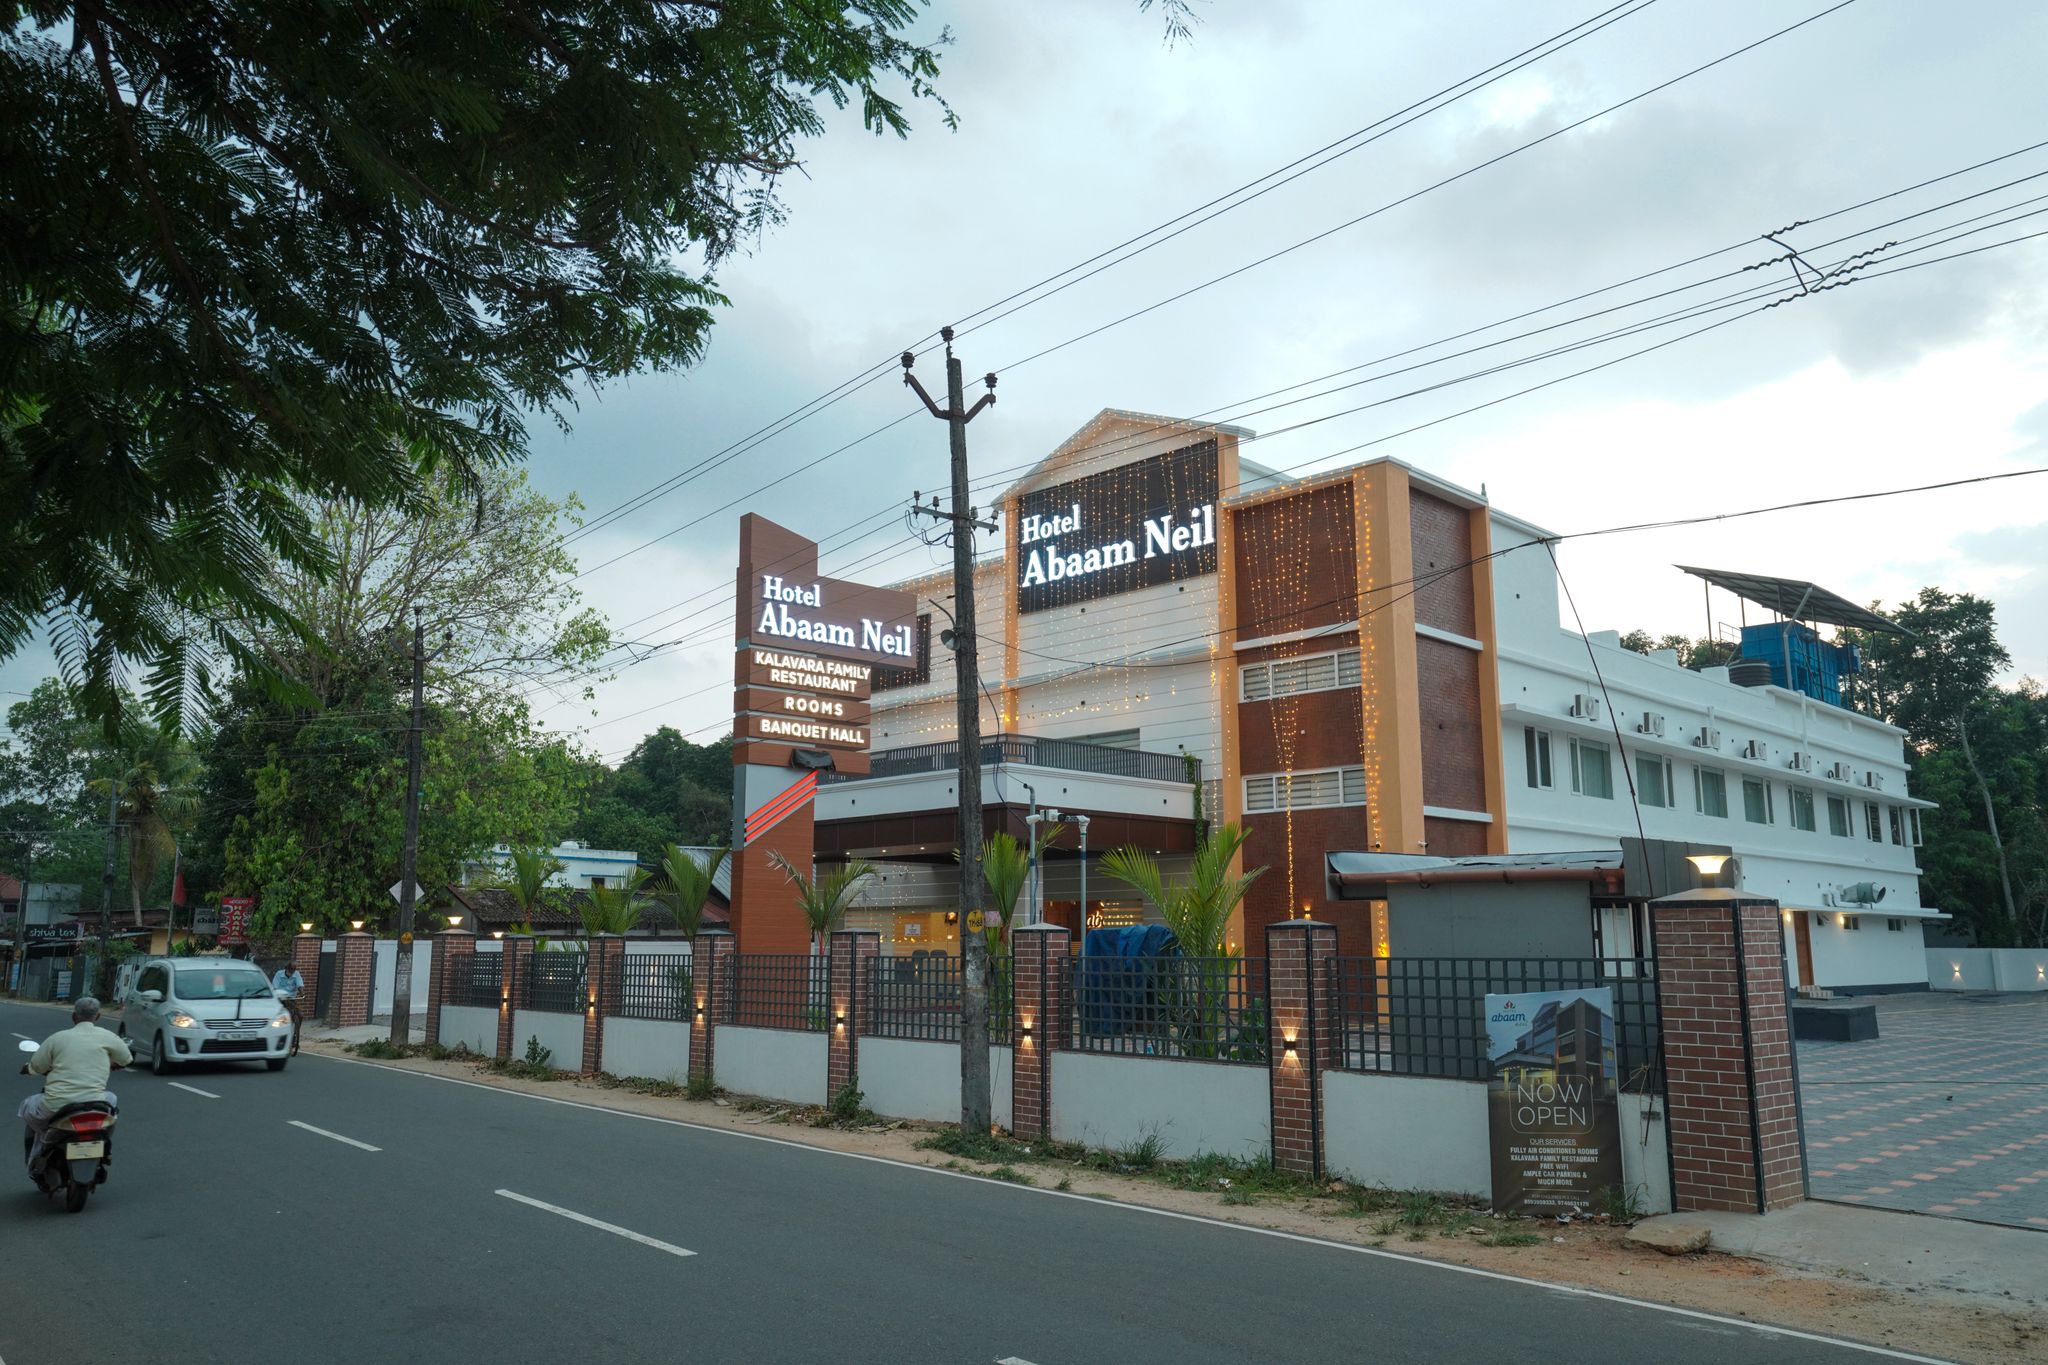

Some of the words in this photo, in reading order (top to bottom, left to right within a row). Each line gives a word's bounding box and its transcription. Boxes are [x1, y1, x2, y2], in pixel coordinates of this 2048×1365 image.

[1021, 504, 1081, 544] Hotel
[1021, 539, 1136, 588] Abaam
[1144, 504, 1216, 559] Neil
[762, 574, 821, 608] Hotel
[758, 602, 856, 648] Abaam
[861, 618, 912, 657] Neil
[754, 651, 824, 674] KALAVARA
[827, 661, 871, 680] FAMILY
[770, 669, 857, 693] RESTAURANT
[784, 696, 844, 717] ROOMS
[760, 719, 826, 740] BANQUET
[830, 727, 865, 744] HALL
[29, 928, 55, 937] shiva
[1491, 1012, 1526, 1022] abaam
[1518, 1083, 1583, 1105] NOW
[1518, 1106, 1586, 1127] OPEN
[1510, 1146, 1526, 1154] FULLY
[1538, 1147, 1576, 1155] CONDITIONED
[1529, 1138, 1545, 1146] OUR
[1546, 1138, 1577, 1146] SERVICES
[1561, 1155, 1598, 1163] RESTAURANT
